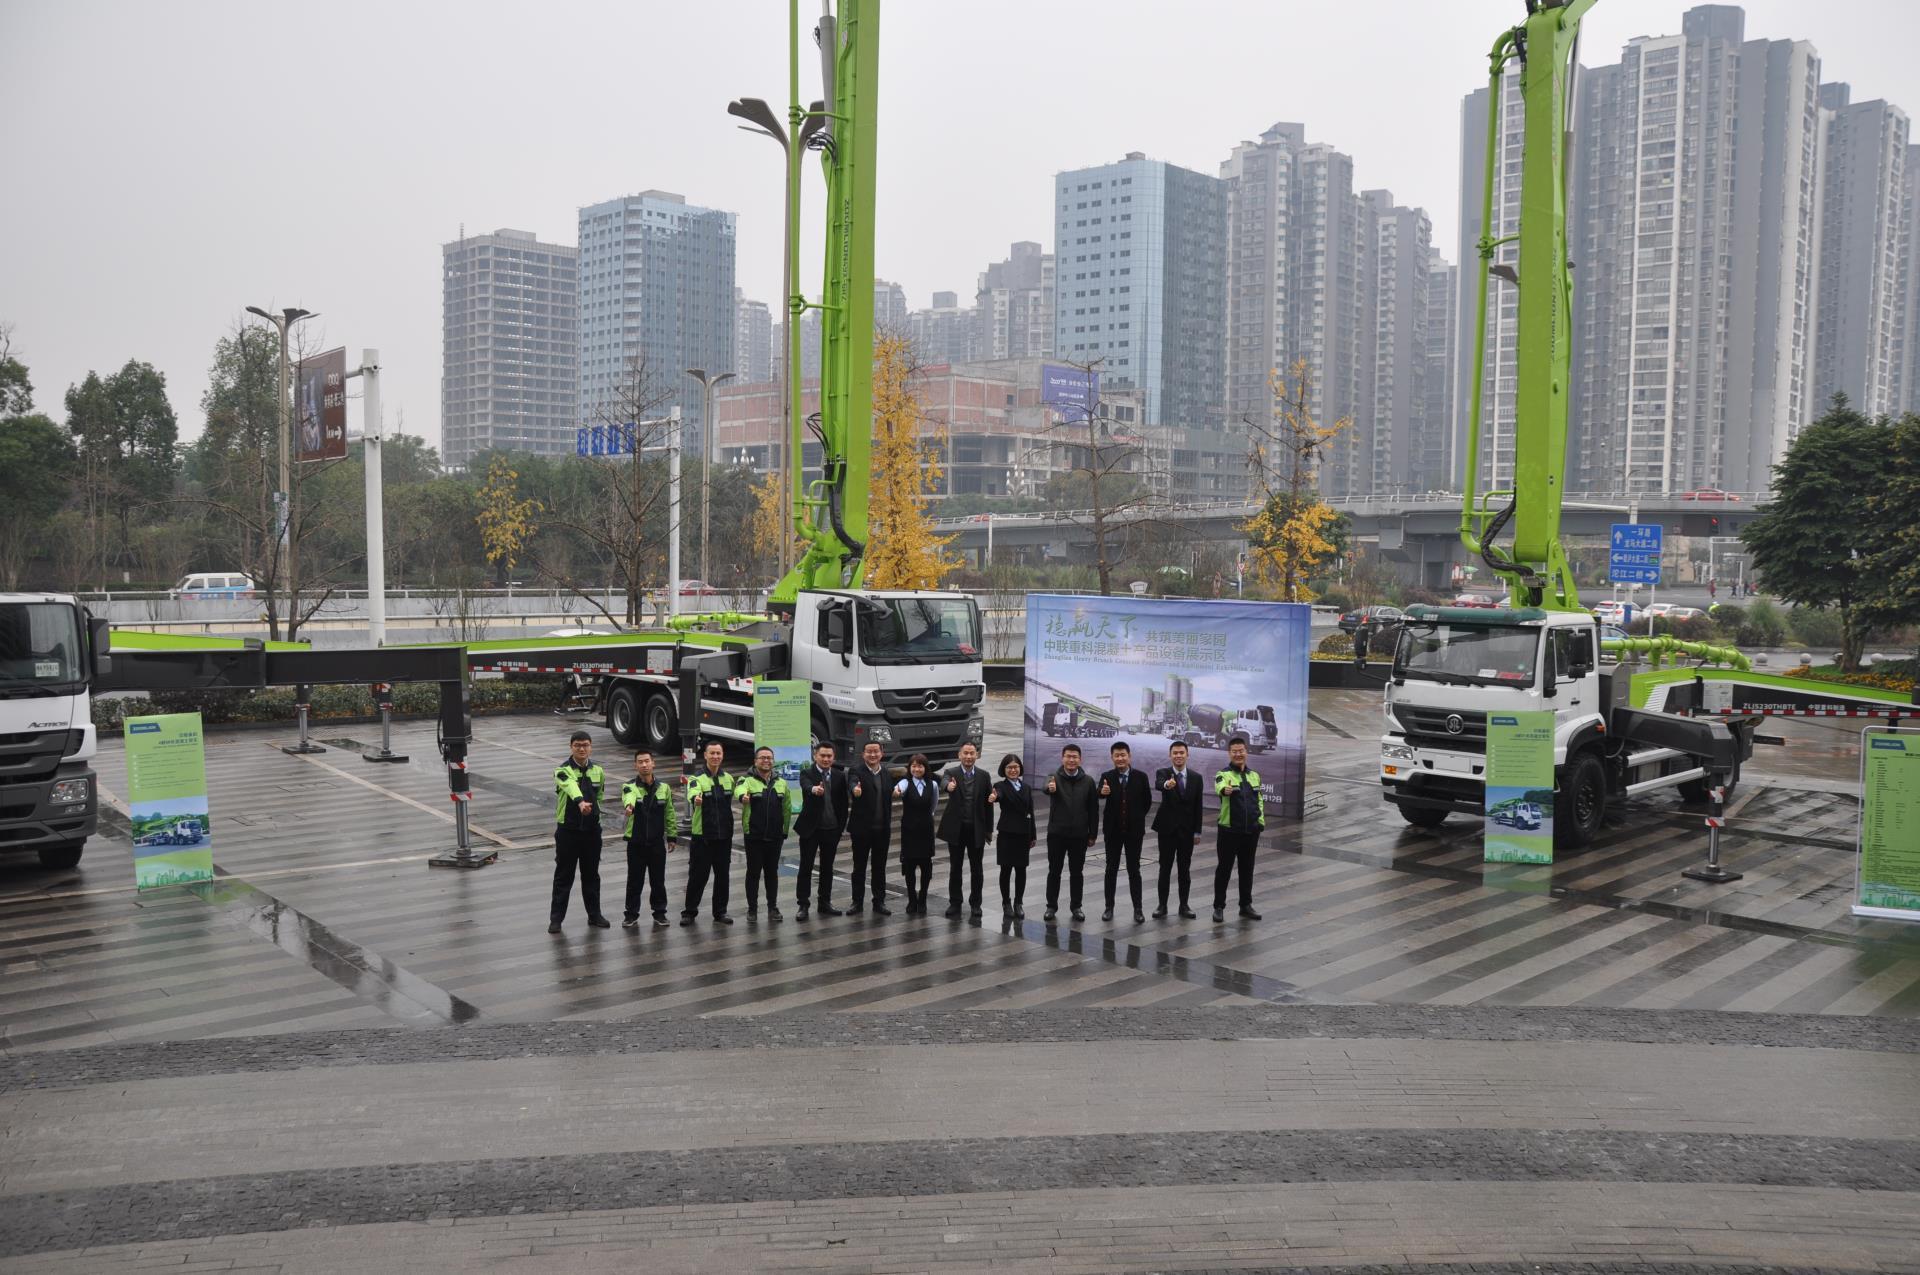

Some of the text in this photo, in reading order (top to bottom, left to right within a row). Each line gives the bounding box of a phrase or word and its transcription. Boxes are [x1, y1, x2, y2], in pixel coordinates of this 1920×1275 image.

[1045, 611, 1227, 647] 稳赢天下 共筑美丽家园
[1044, 638, 1226, 662] 中联重科混凝土产品设备展示区
